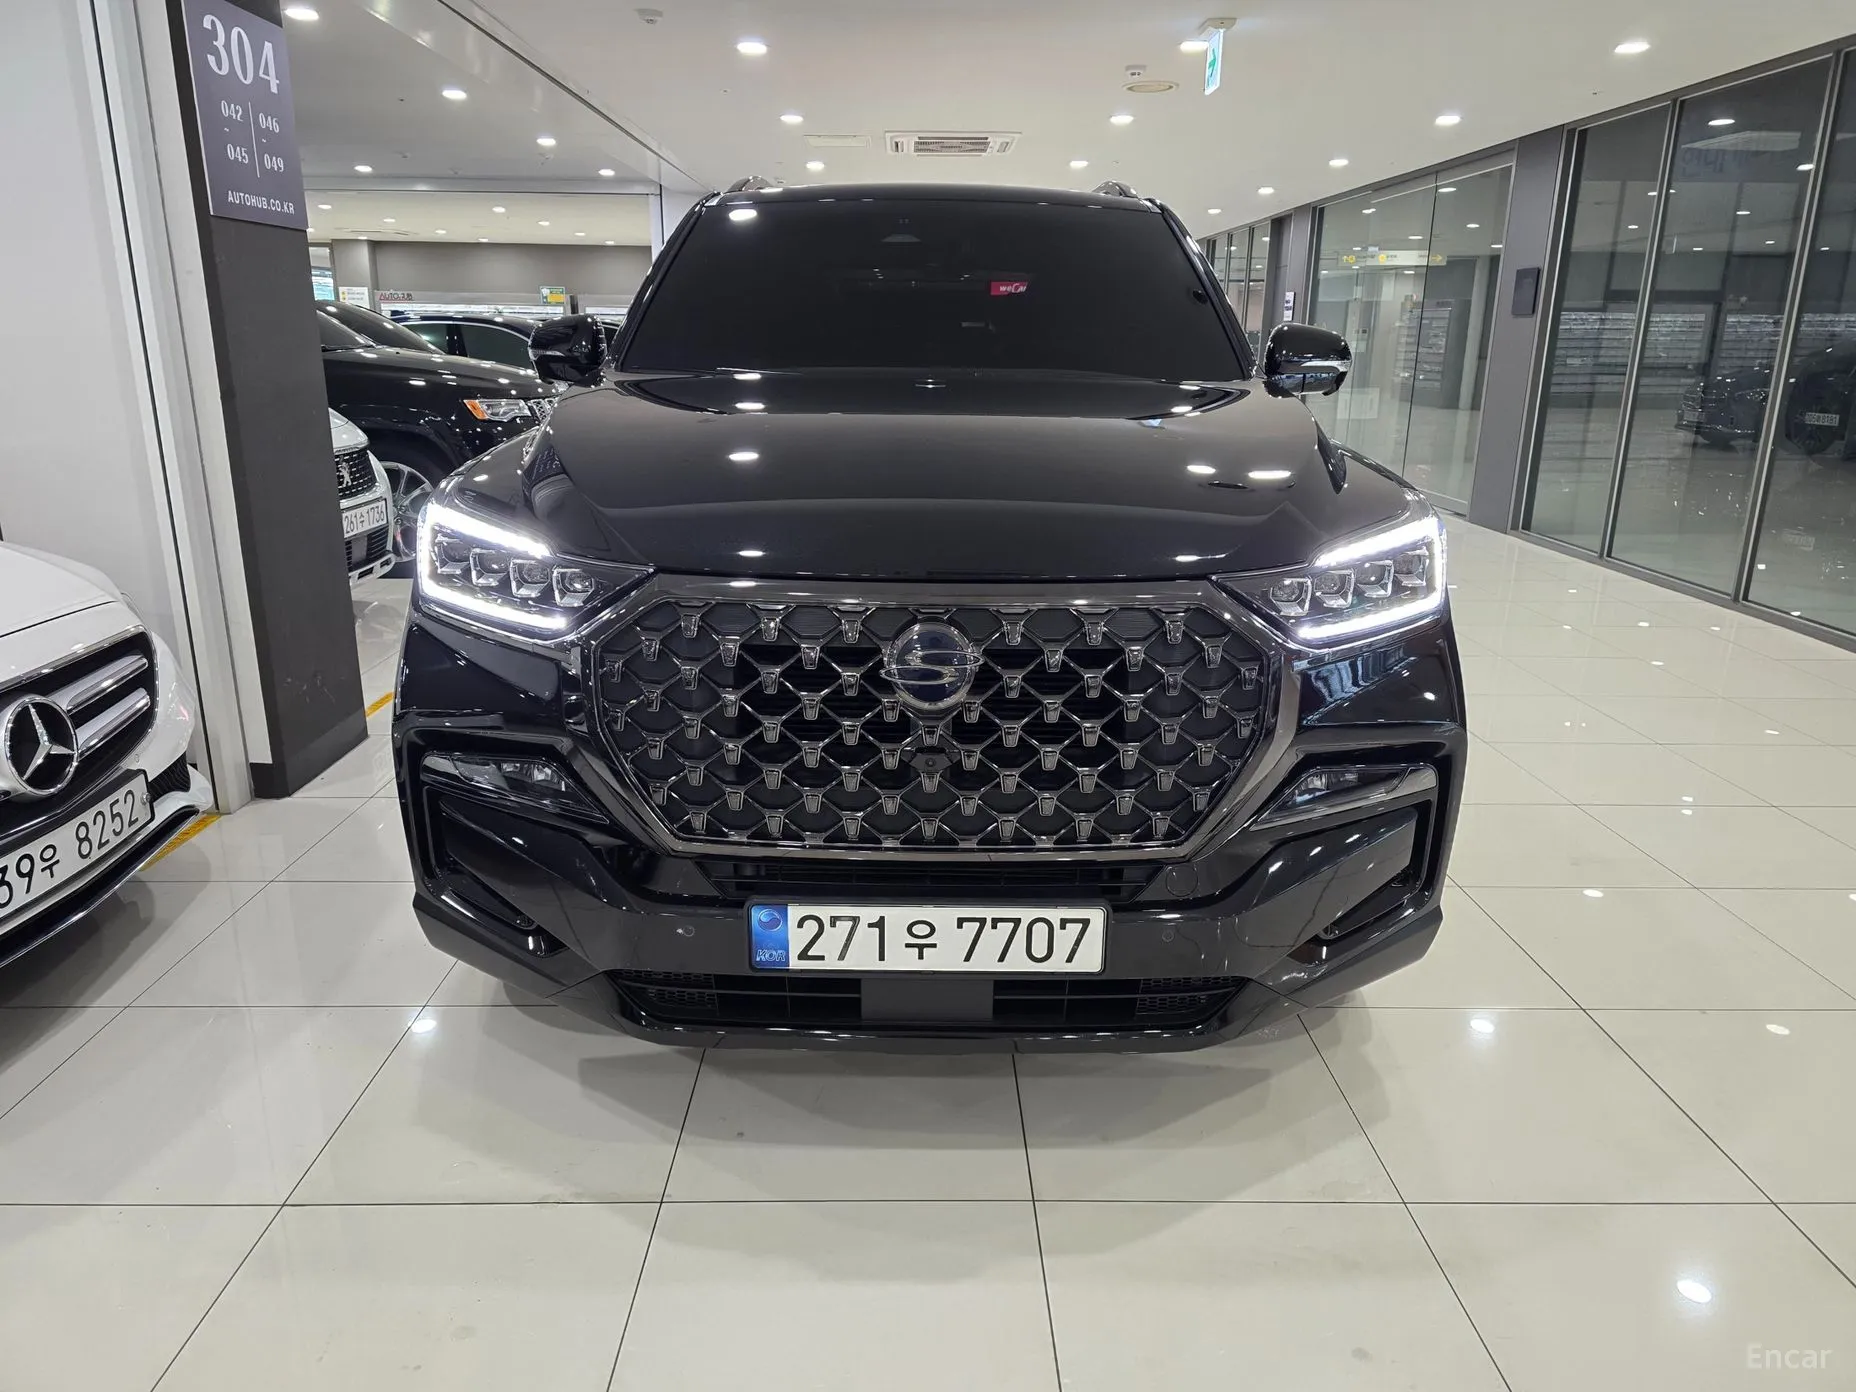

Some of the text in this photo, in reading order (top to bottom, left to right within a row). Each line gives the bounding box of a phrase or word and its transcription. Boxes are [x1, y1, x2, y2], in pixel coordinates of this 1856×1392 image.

[203, 14, 279, 94] 304
[221, 100, 244, 121] 042
[259, 112, 280, 133] 046
[227, 143, 249, 164] 045
[264, 153, 284, 173] 049
[228, 190, 295, 215] AUTOHUB.CO.KR
[75, 789, 139, 860] 8252
[956, 917, 1091, 964] 7707
[756, 949, 786, 962] KOR
